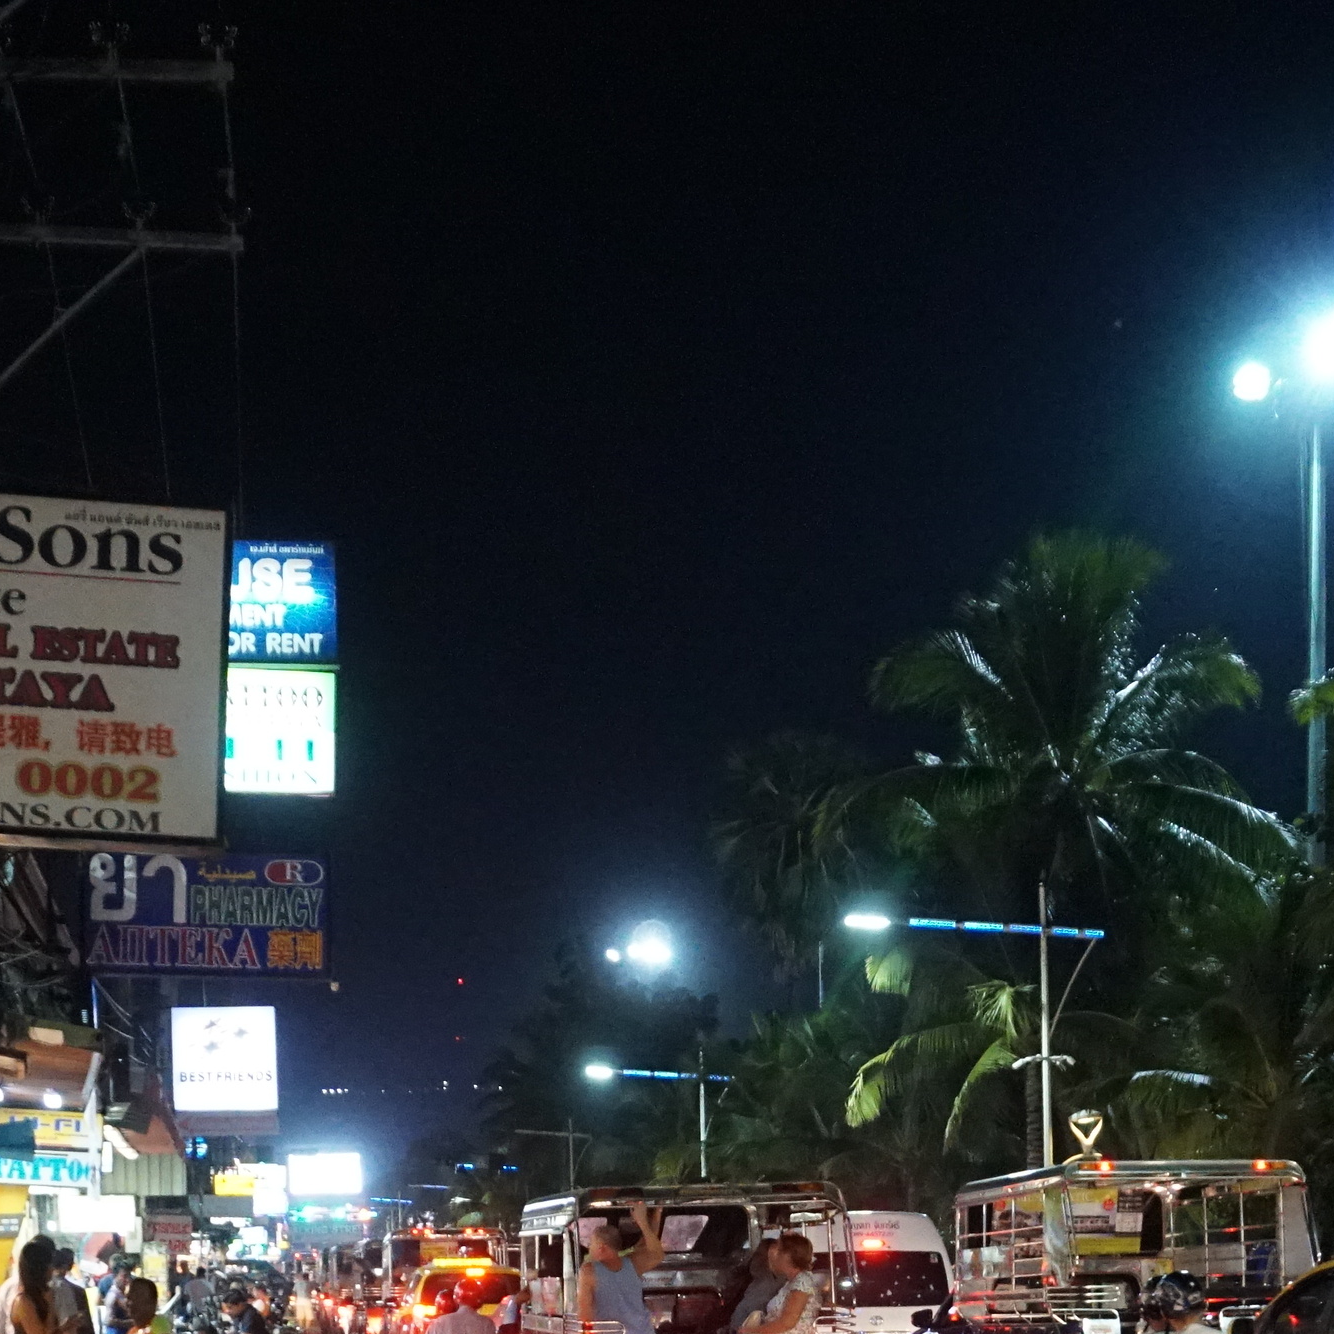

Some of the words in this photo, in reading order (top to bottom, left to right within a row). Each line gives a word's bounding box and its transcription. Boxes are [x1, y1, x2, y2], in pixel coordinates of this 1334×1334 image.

[30, 625, 180, 669] ESTATE
[267, 632, 324, 655] RENT
[16, 758, 161, 804] 0002
[89, 852, 187, 923] ยา
[190, 884, 323, 927] PHARMACY
[180, 1071, 211, 1082] BEST
[217, 1070, 272, 1082] FRIENDS
